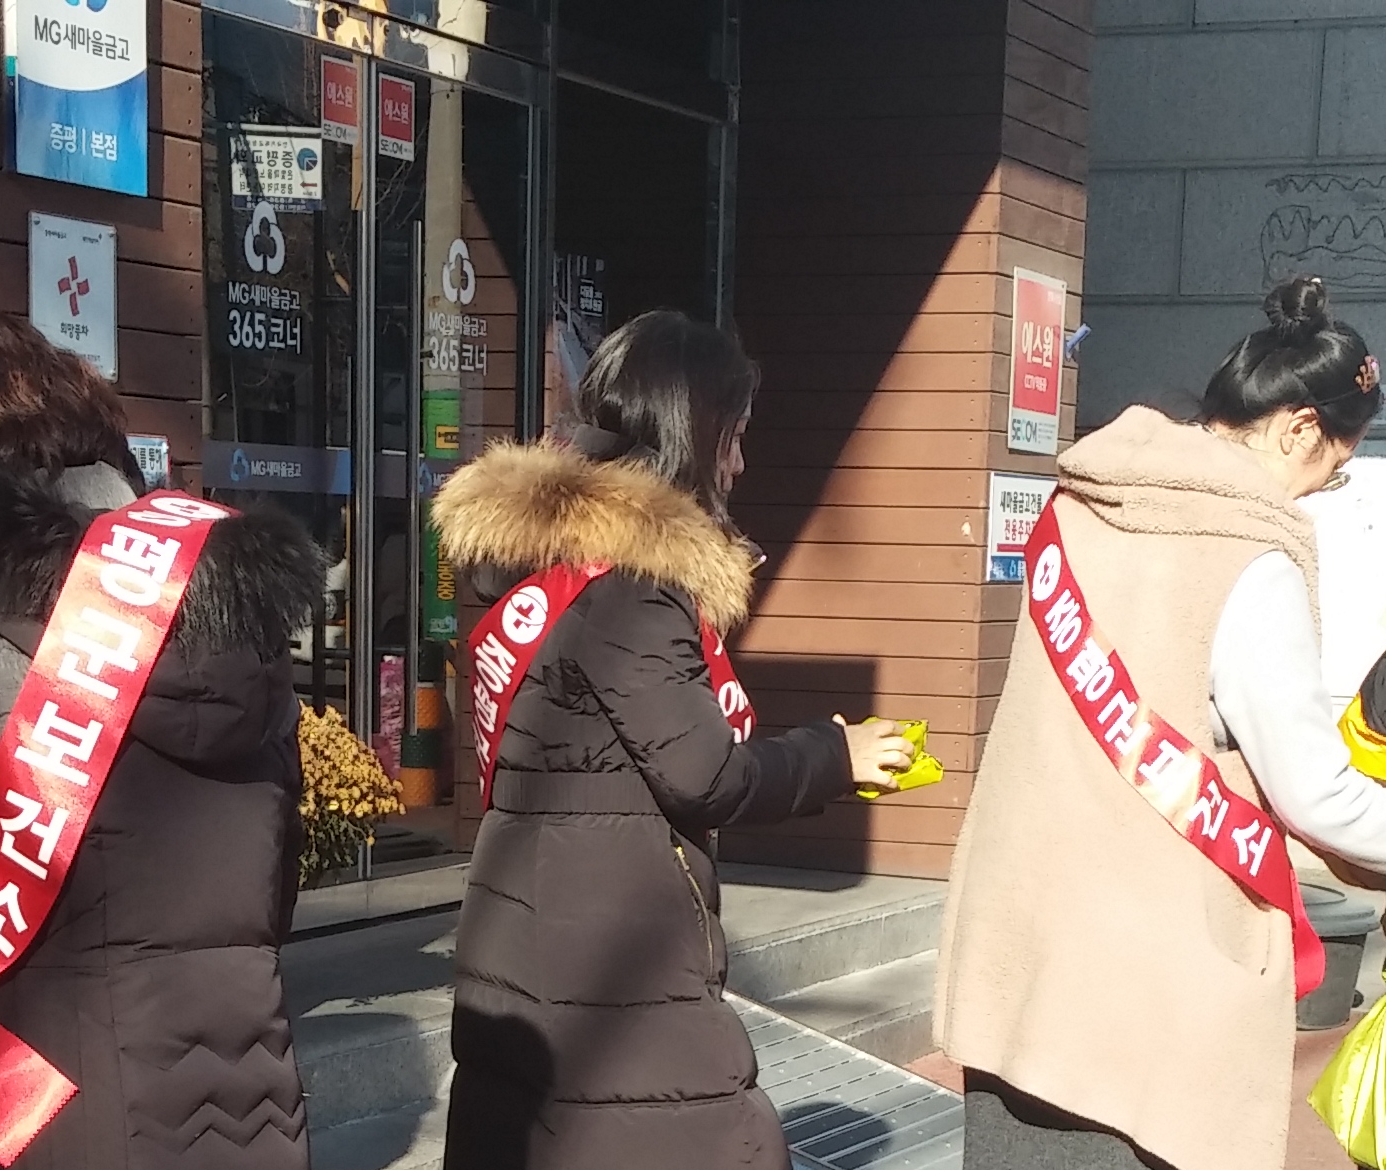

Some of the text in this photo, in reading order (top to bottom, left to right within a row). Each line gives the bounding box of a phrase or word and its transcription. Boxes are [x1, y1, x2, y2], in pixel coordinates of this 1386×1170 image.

[34, 14, 130, 61] MG새마을금고
[326, 80, 353, 109] 에스원
[384, 96, 409, 125] 에스원
[50, 122, 118, 162] 증평 본점
[228, 281, 301, 310] MG새마을금고
[428, 312, 488, 337] MG새마을금고
[1021, 320, 1054, 369] 에스원
[1004, 518, 1036, 541] 전용주차
